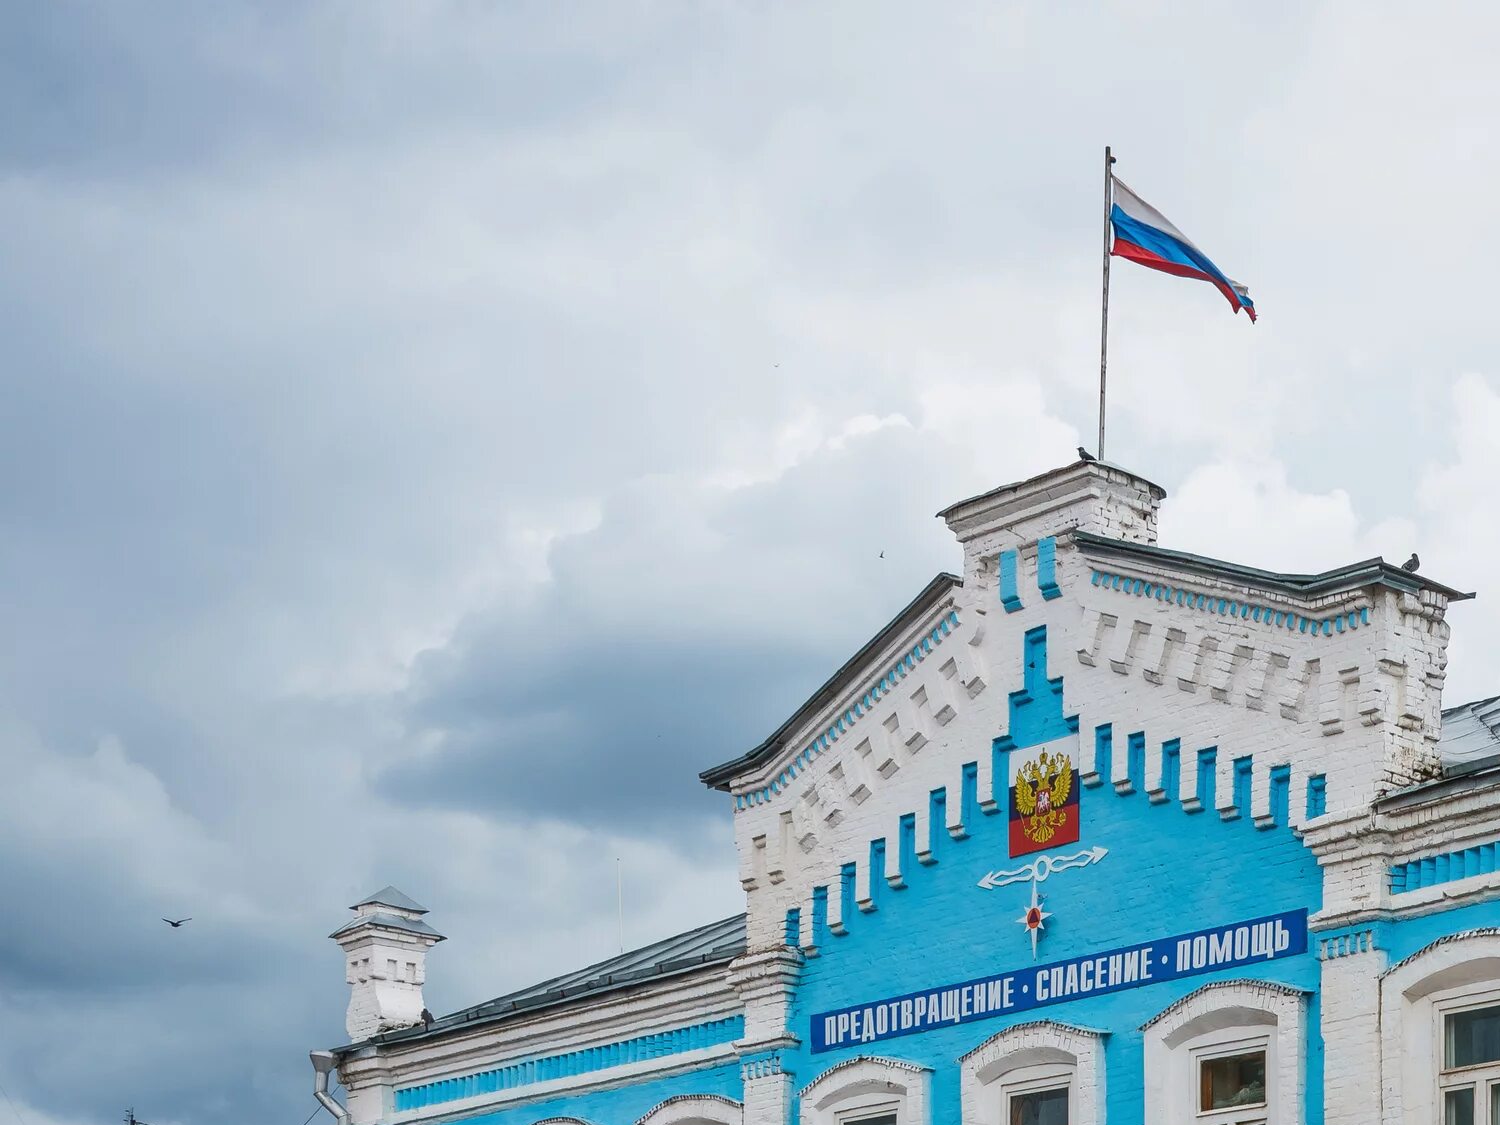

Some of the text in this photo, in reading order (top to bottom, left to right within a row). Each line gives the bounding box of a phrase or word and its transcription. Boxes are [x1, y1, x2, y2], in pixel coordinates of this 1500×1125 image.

[824, 919, 1290, 1046] ПРЕДОТВРАЩЕНИЕ СПАСЕНИЕ ПОМОЩЬ
